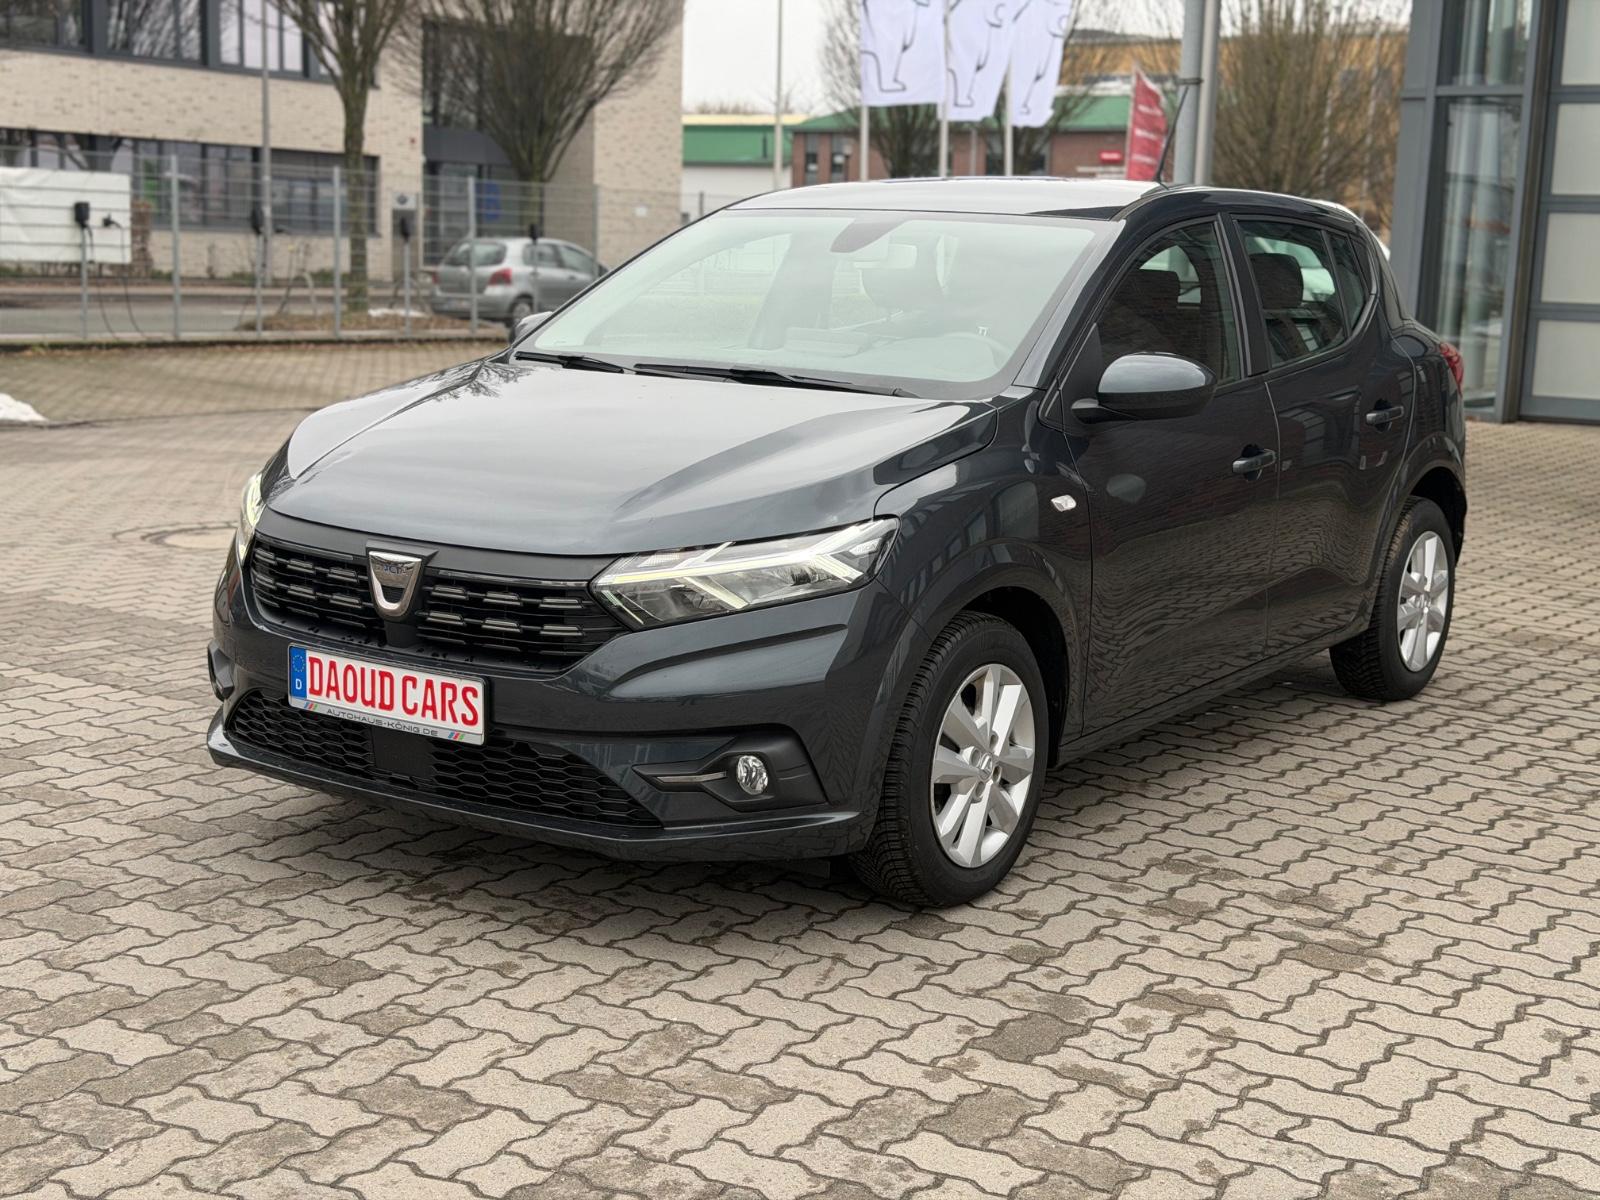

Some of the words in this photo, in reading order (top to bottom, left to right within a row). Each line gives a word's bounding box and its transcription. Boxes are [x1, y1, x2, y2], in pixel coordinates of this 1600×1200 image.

[295, 678, 303, 690] D
[308, 656, 395, 712] DAOUD
[401, 675, 479, 727] CARS
